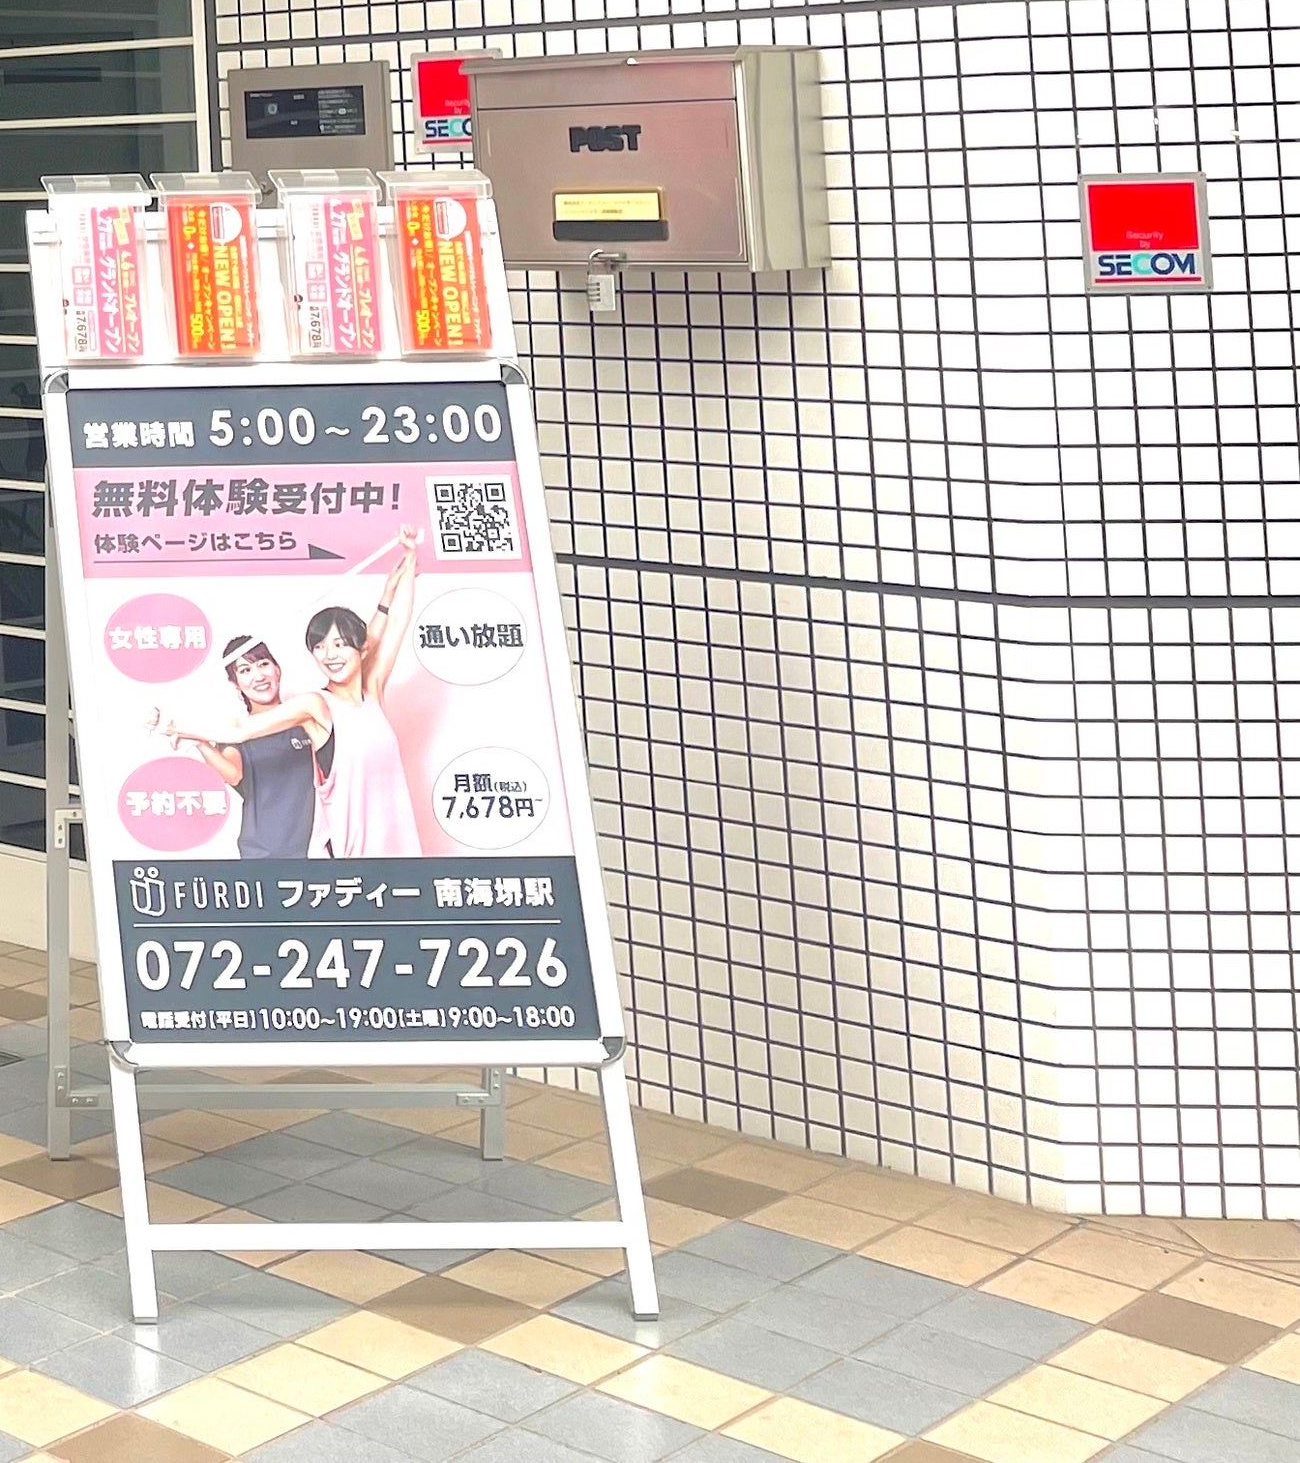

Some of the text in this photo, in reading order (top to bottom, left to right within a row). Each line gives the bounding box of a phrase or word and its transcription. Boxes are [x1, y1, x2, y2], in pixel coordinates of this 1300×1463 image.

[568, 125, 642, 153] POST
[1125, 230, 1164, 240] Security
[1139, 240, 1151, 248] by
[212, 245, 232, 288] NEW
[437, 239, 458, 283] NEW
[1098, 252, 1196, 276] SECOM
[216, 290, 237, 350] OPEN!
[442, 286, 464, 346] OPEN!
[82, 421, 195, 450] 営業時間
[93, 530, 298, 555] 体験ページはこちら
[109, 624, 207, 651] 女性専用
[418, 622, 524, 650] 通い放題
[125, 790, 227, 817] 予約不要
[173, 876, 555, 911] FÜRDI ファディー 南海堺駅
[135, 937, 568, 991] 072-247-7226
